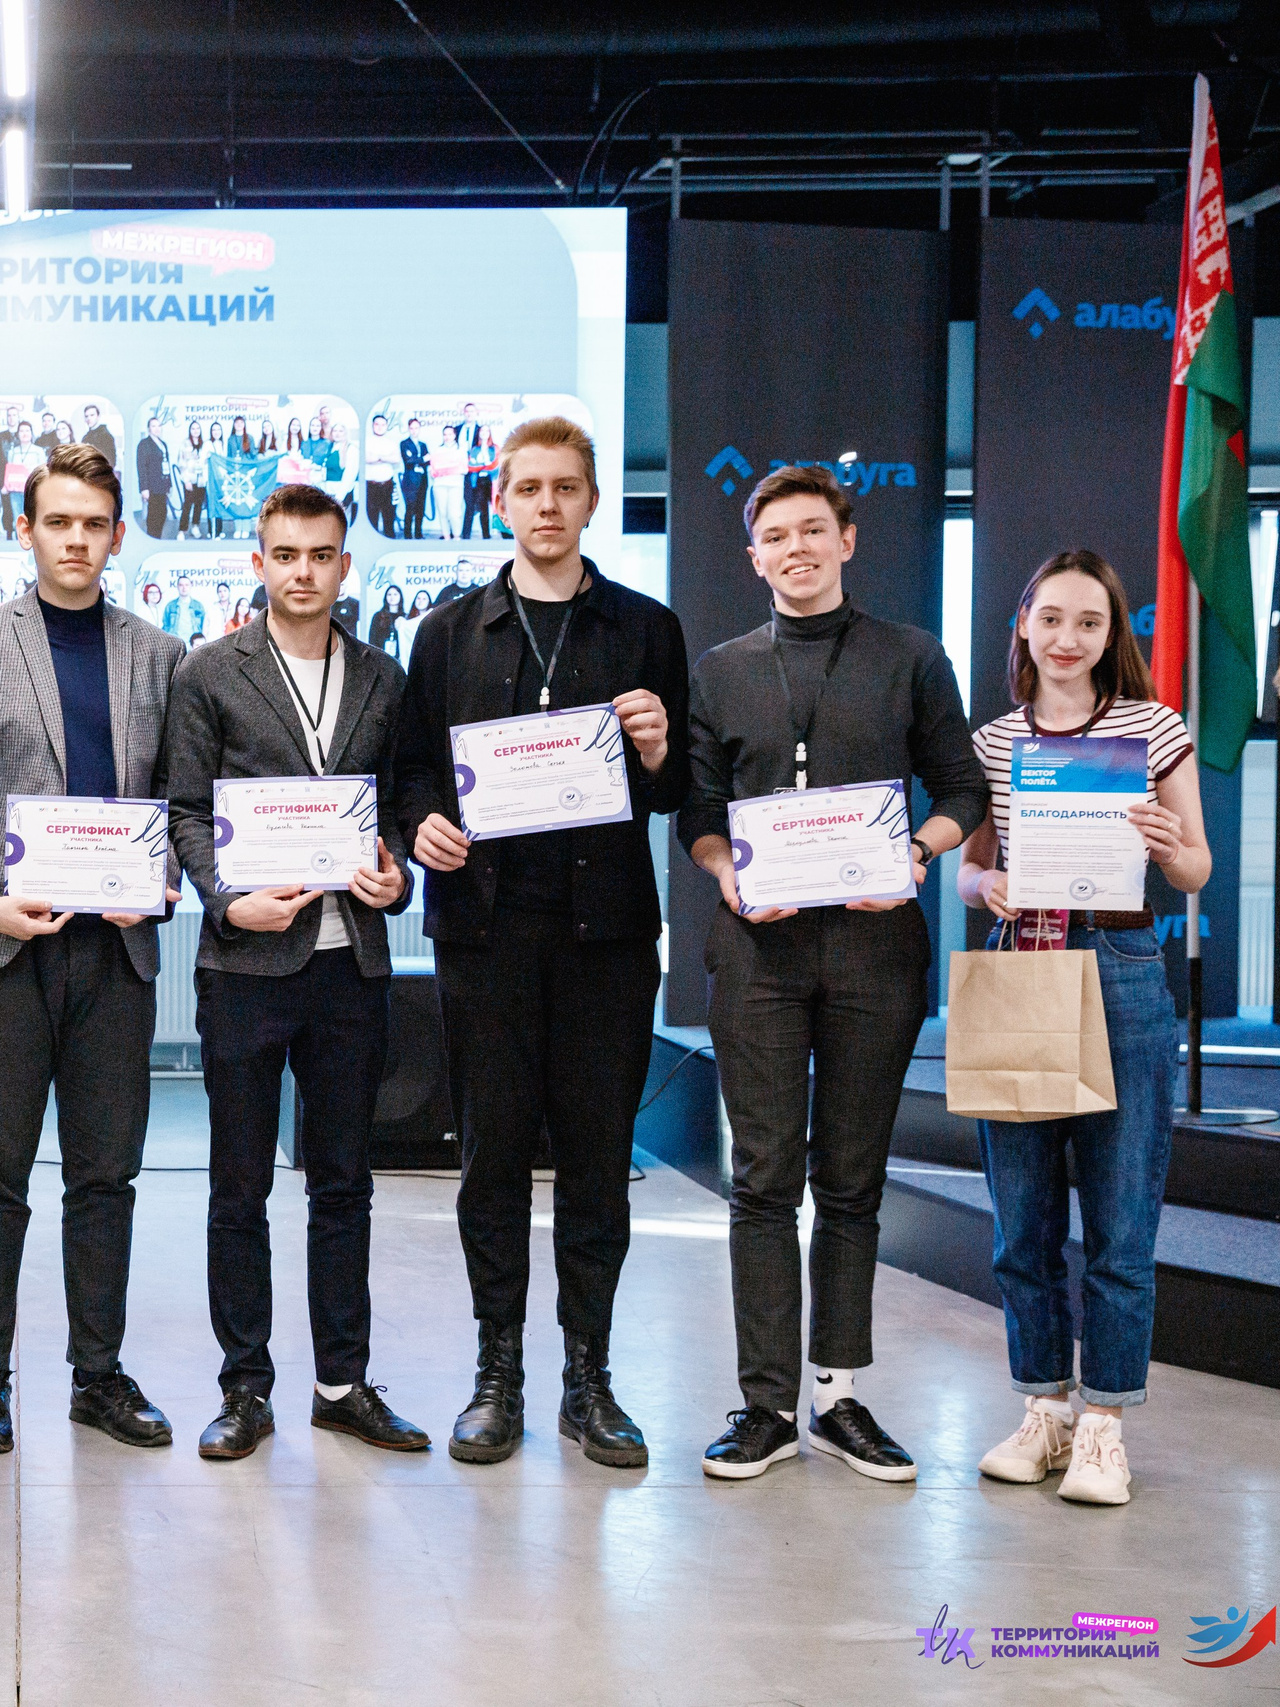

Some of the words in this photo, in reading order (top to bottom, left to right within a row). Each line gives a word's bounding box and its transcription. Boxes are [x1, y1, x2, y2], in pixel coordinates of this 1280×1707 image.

[102, 230, 265, 261] МЕЖРЕГИОН
[1074, 297, 1176, 340] алабу
[169, 568, 244, 577] ТЕРРИТОРИЯ
[494, 736, 581, 758] СЕРТИФИКАТ
[519, 752, 554, 762] УЧАСТНИКА
[1021, 769, 1056, 777] ВЕКТОР
[1020, 777, 1058, 786] ПОЛЁТА
[254, 803, 339, 814] СЕРТИФИКАТ
[1020, 809, 1127, 819] БЛАГОДАРНОСТЬ
[772, 812, 864, 832] СЕРТИФИКАТ
[46, 824, 131, 836] СЕРТИФИКАТ
[799, 828, 835, 836] УЧАСТНИКА
